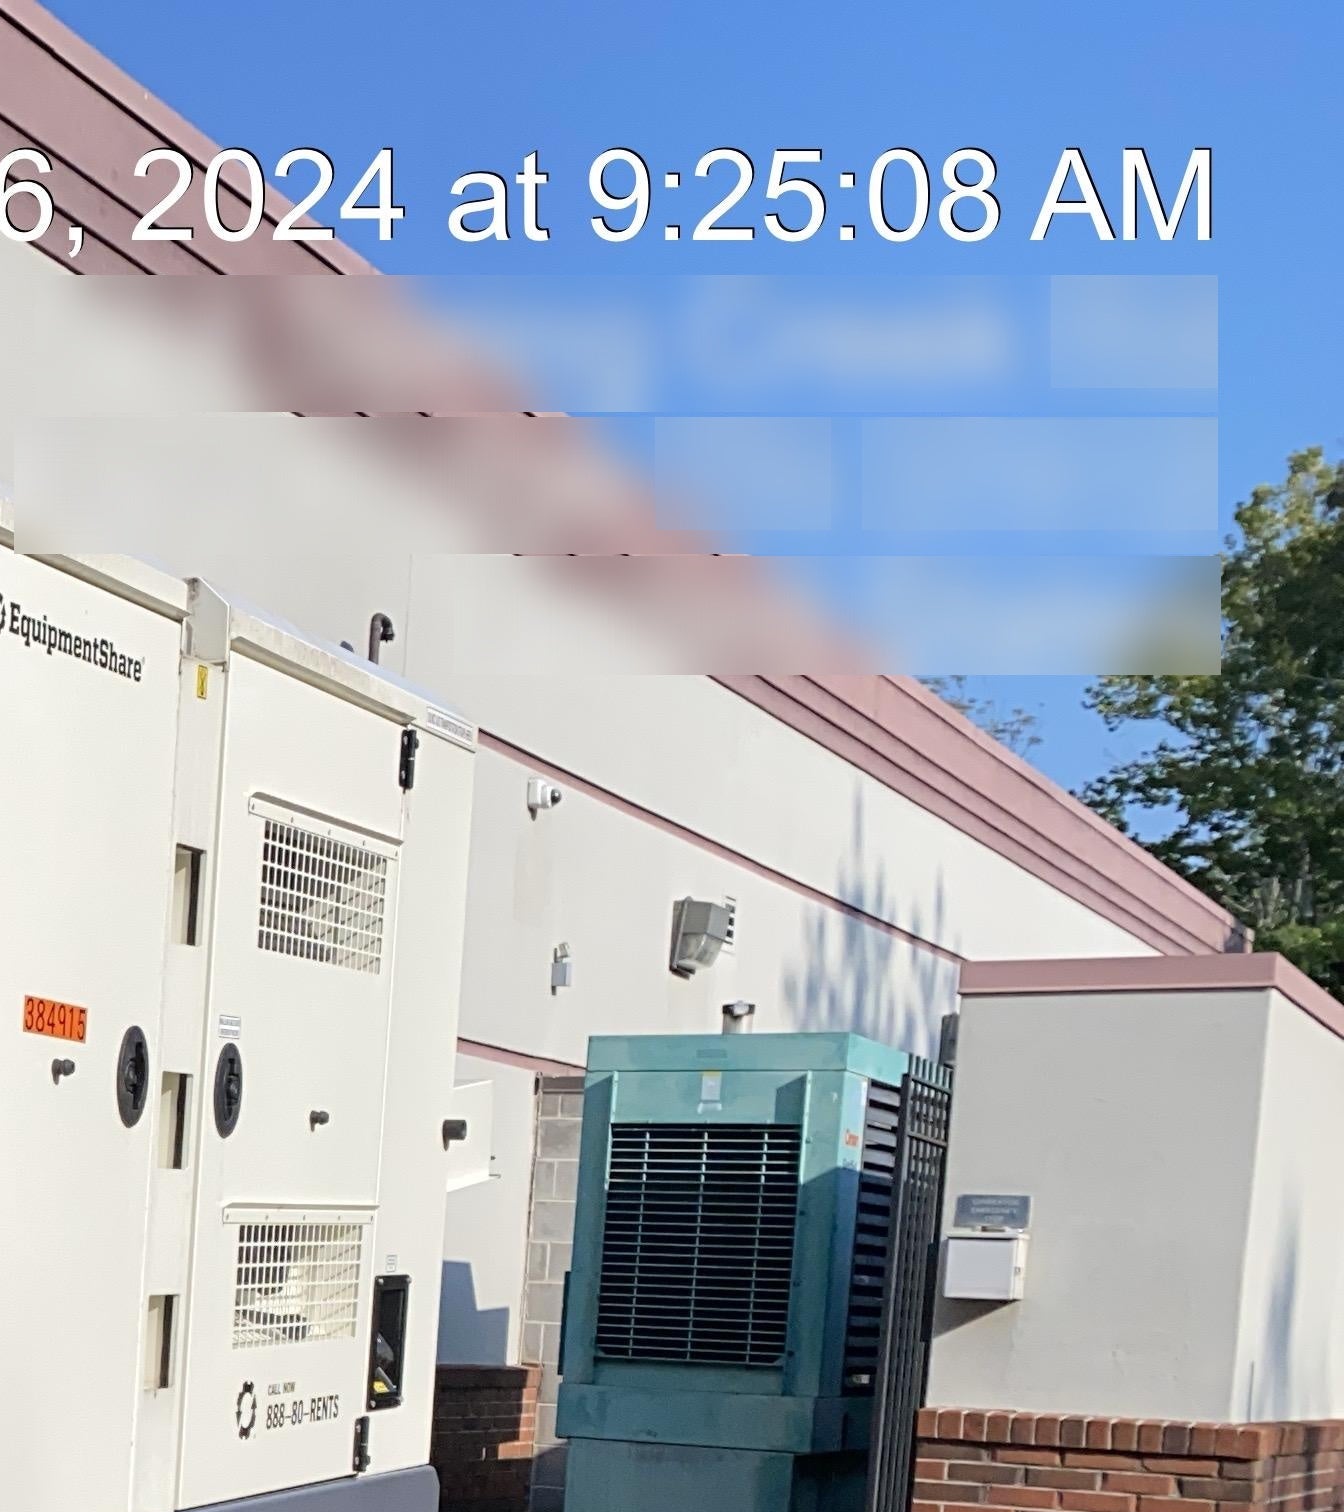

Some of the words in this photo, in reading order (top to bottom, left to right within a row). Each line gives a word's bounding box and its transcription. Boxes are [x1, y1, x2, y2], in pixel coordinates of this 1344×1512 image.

[8, 601, 142, 682] EquipmentShare
[25, 997, 86, 1040] 384915
[267, 1383, 281, 1396] CALL
[282, 1382, 296, 1394] NOW
[266, 1394, 339, 1430] 888-80-RENTS
